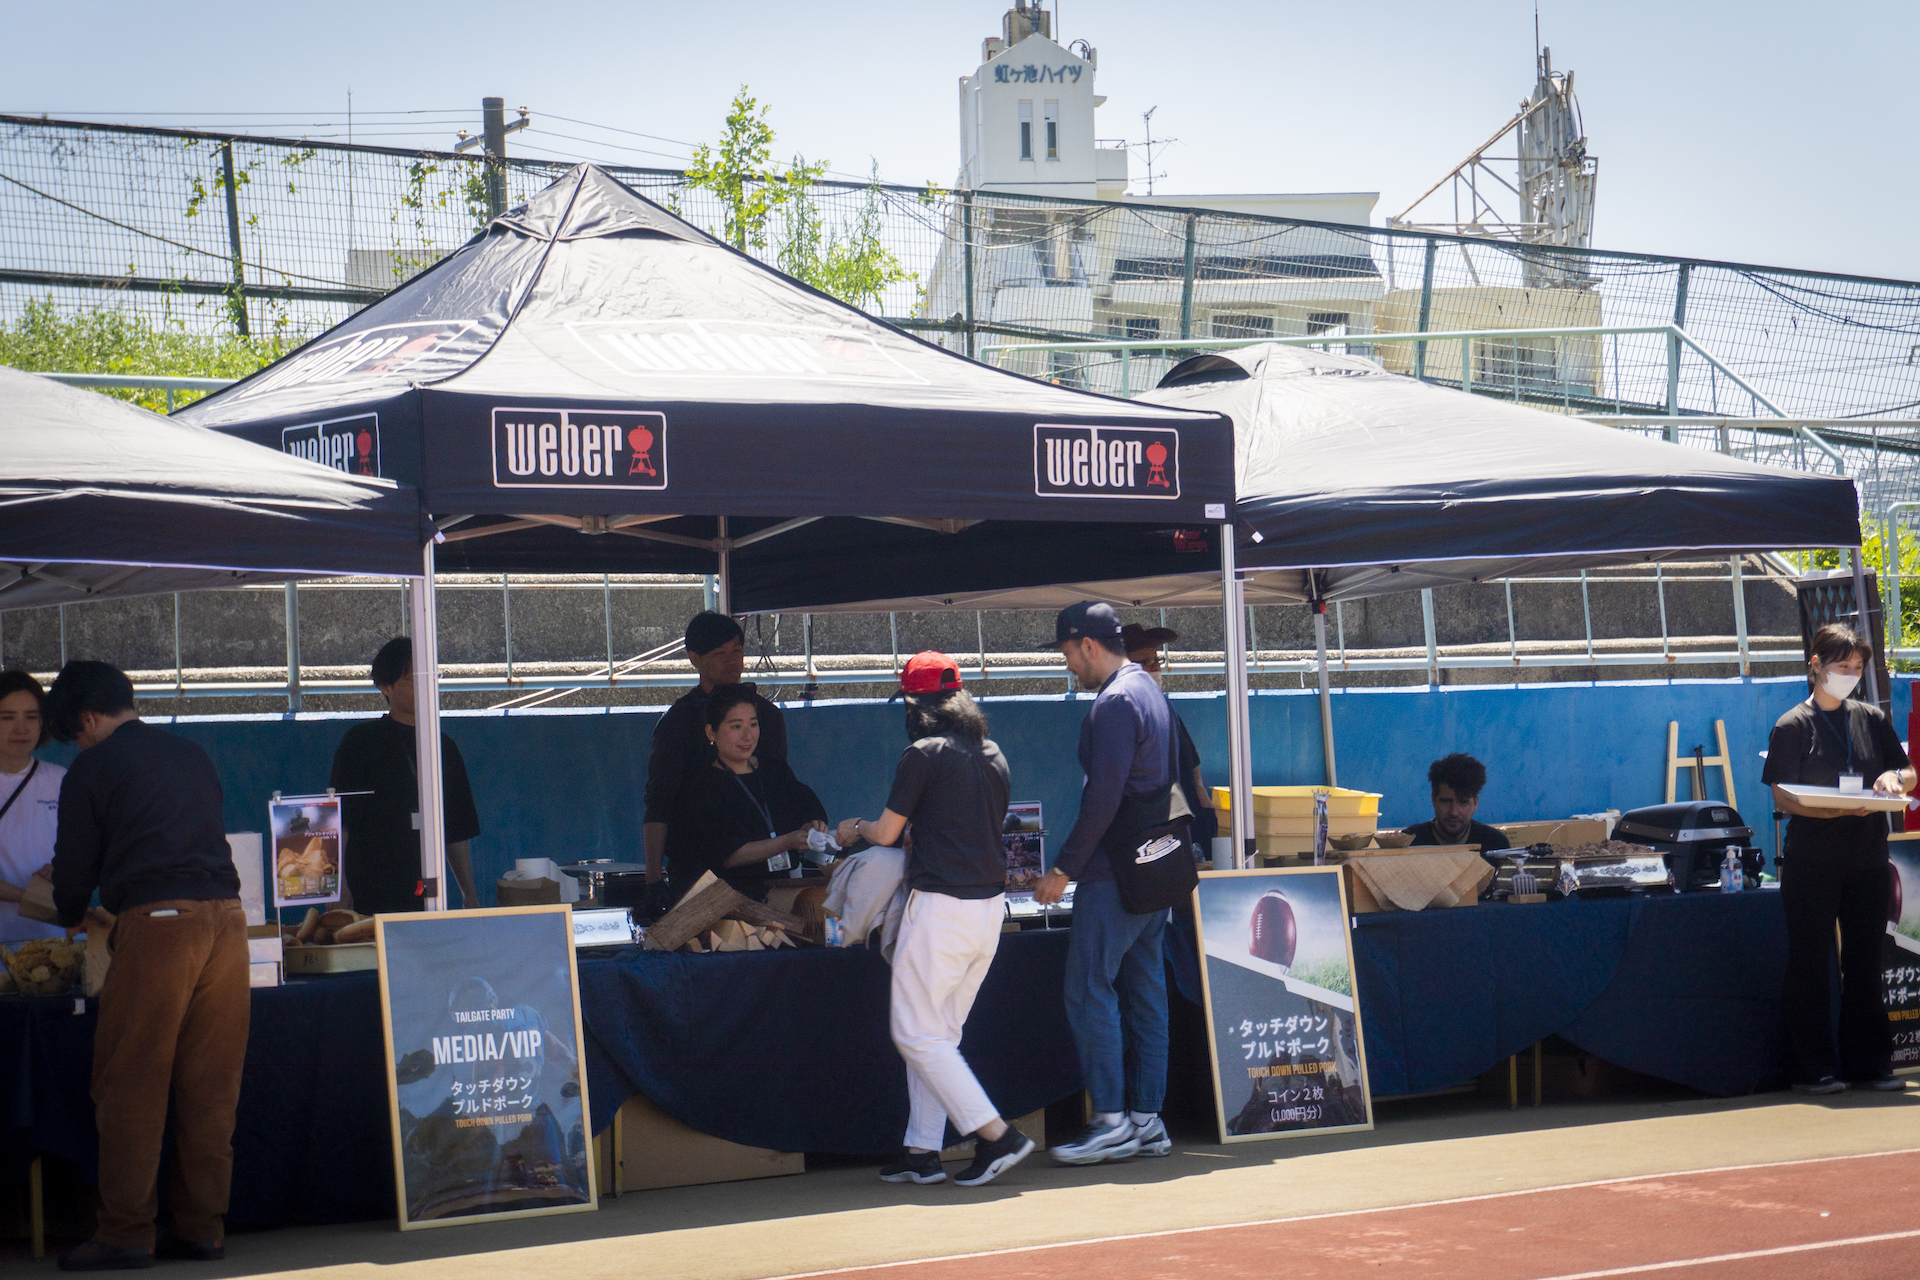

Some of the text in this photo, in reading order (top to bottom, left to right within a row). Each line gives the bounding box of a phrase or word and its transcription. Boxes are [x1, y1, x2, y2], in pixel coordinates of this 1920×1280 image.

[599, 321, 828, 374] weber
[504, 411, 623, 477] weber
[1045, 428, 1143, 488] weber
[455, 1008, 515, 1023] TAILGATE PARTY
[1239, 1015, 1328, 1038] タッチダウン
[432, 1030, 542, 1065] MEDIA/VIP
[1241, 1036, 1330, 1060] プルドポーク
[1247, 1061, 1337, 1079] TOUCH DOWN PULLED PORK
[451, 1076, 532, 1096] タッチダウン
[452, 1094, 533, 1115] プルドポーク
[1270, 1104, 1322, 1123] (1,000円分)
[455, 1113, 533, 1128] TOUCH DOWN PULLED PORK
